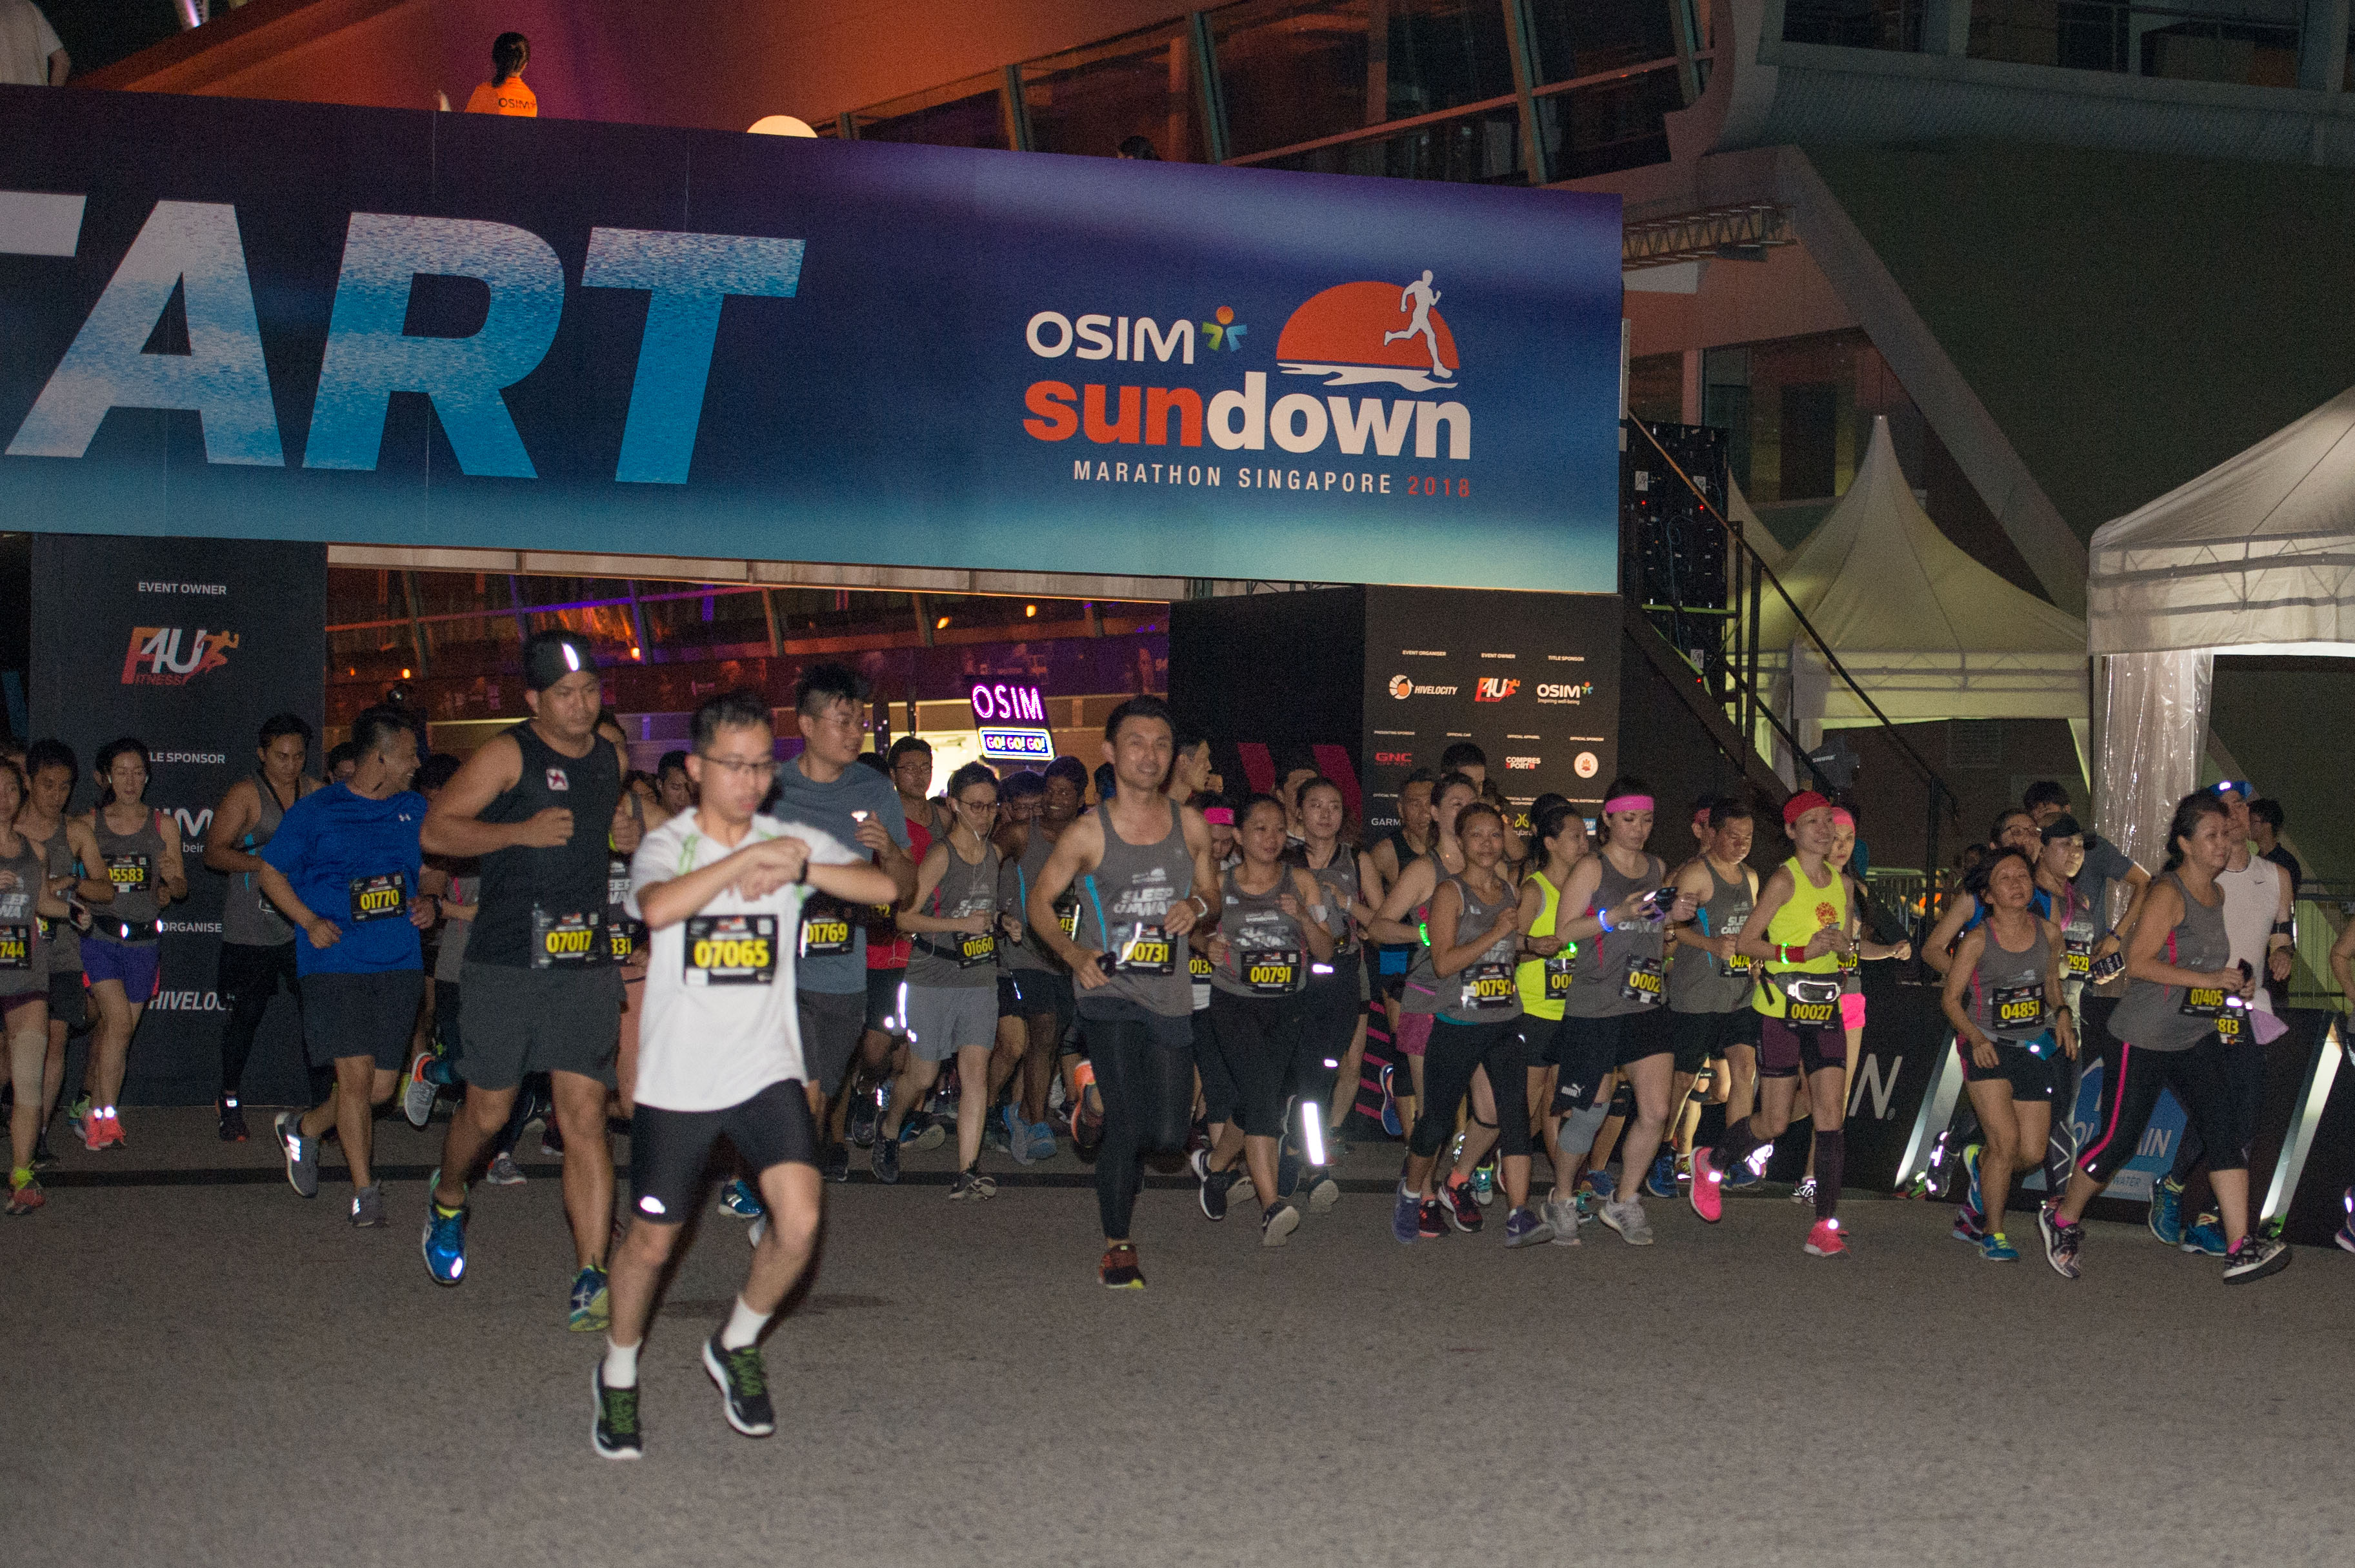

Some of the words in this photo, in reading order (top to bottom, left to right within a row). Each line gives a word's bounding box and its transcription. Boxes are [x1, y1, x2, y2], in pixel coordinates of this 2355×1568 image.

[498, 98, 529, 109] OSIM
[1025, 311, 1194, 364] OSIM
[1023, 371, 1471, 459] sundown
[1074, 460, 1221, 487] MARATHON
[1238, 468, 1392, 494] SINGAPORE
[1407, 476, 1470, 498] 2018
[138, 582, 178, 593] EVENT
[181, 584, 226, 594] OWNER
[1414, 685, 1458, 695] HIVELOCITY
[1537, 684, 1580, 698] OSIM
[972, 684, 1044, 720] OSIM
[986, 736, 1006, 750] GO!
[1007, 736, 1025, 751] GO!
[1027, 737, 1046, 752] GO!
[149, 752, 164, 762] LE
[166, 753, 225, 764] SPONSOR
[1374, 752, 1412, 762] GNC
[1506, 756, 1541, 765] COMPRES
[1371, 818, 1401, 826] GARM
[360, 889, 399, 910] 01770
[162, 923, 223, 932] ORGANISE
[546, 930, 593, 953] 07017
[963, 936, 994, 957] 01660
[694, 938, 770, 968] 07065
[1123, 941, 1169, 963] 00731
[1250, 967, 1292, 983] 00791
[1470, 979, 1513, 998] 00792
[2190, 989, 2224, 1007] 07405
[1791, 1003, 1834, 1021] 00027
[2001, 1001, 2040, 1020] 04851
[2214, 1018, 2240, 1034] 813
